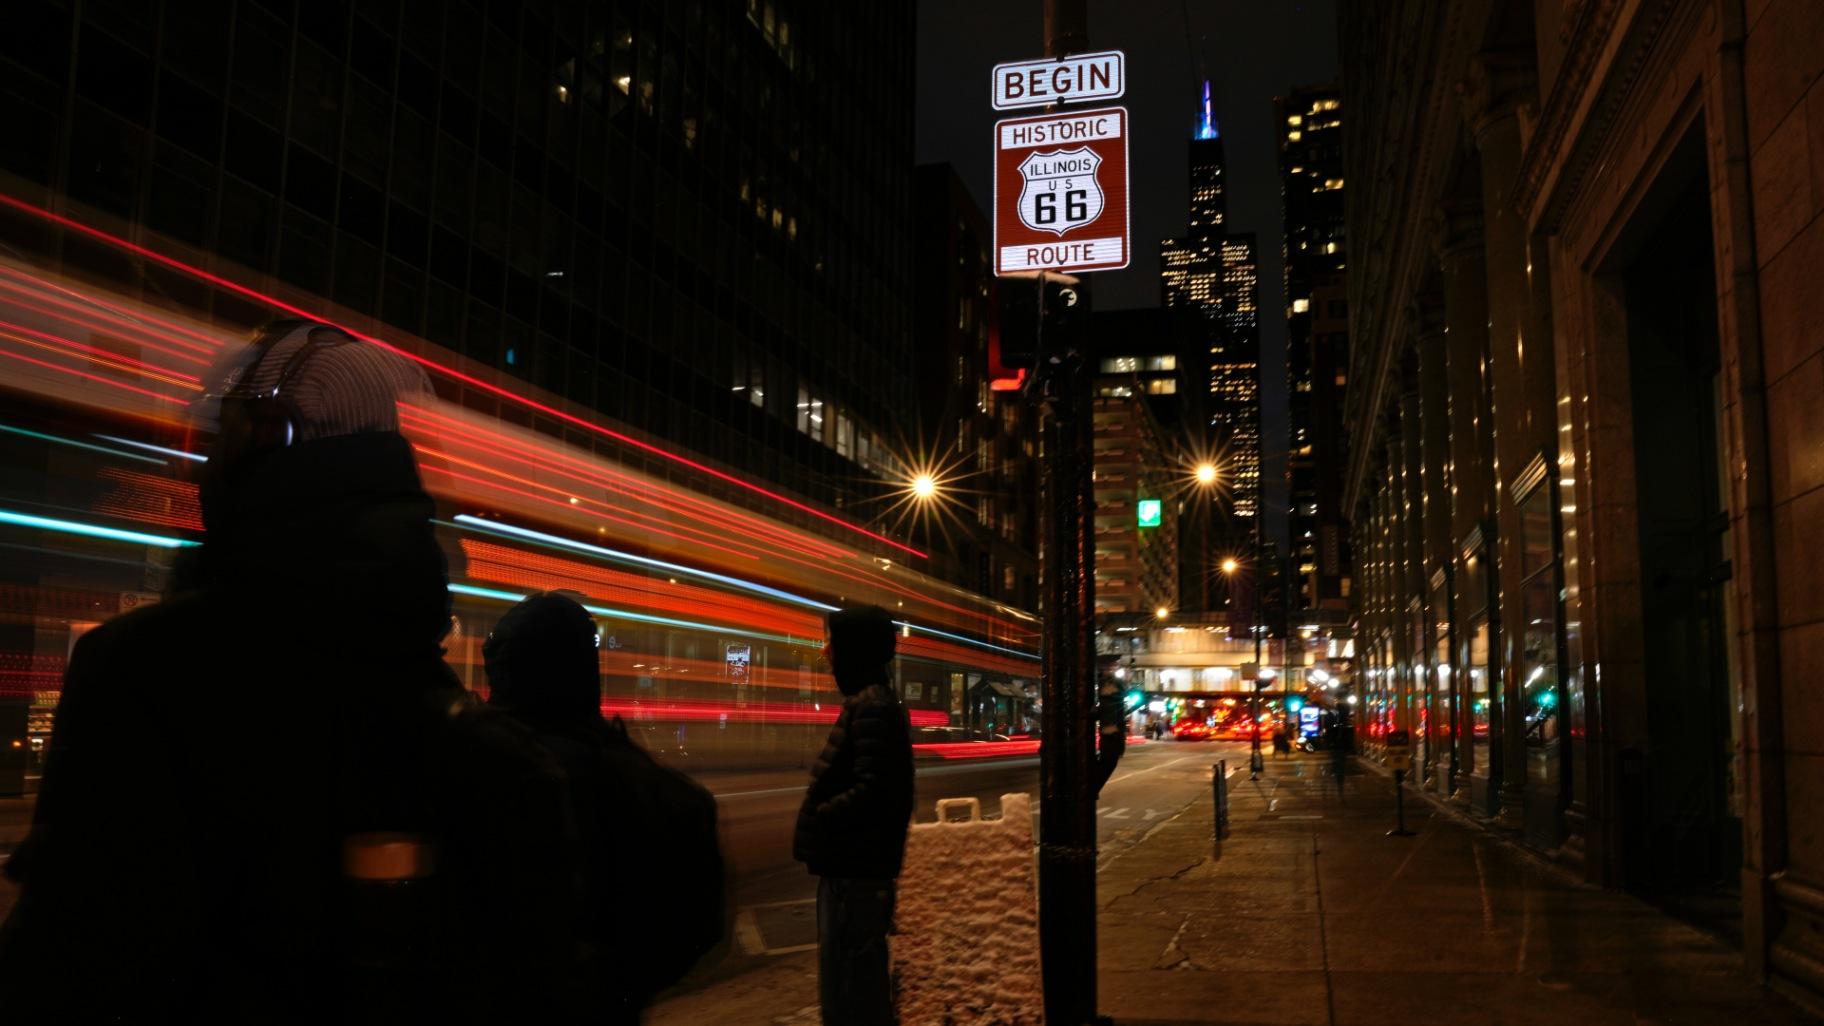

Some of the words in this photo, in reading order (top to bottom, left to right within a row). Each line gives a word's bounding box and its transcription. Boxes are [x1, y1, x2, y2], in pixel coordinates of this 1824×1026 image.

[1004, 61, 1111, 100] BEGIN
[1013, 118, 1108, 145] HISTORIC
[1030, 158, 1092, 177] ILLINOIS
[1035, 189, 1087, 225] 66
[1027, 243, 1095, 266] ROUTE
